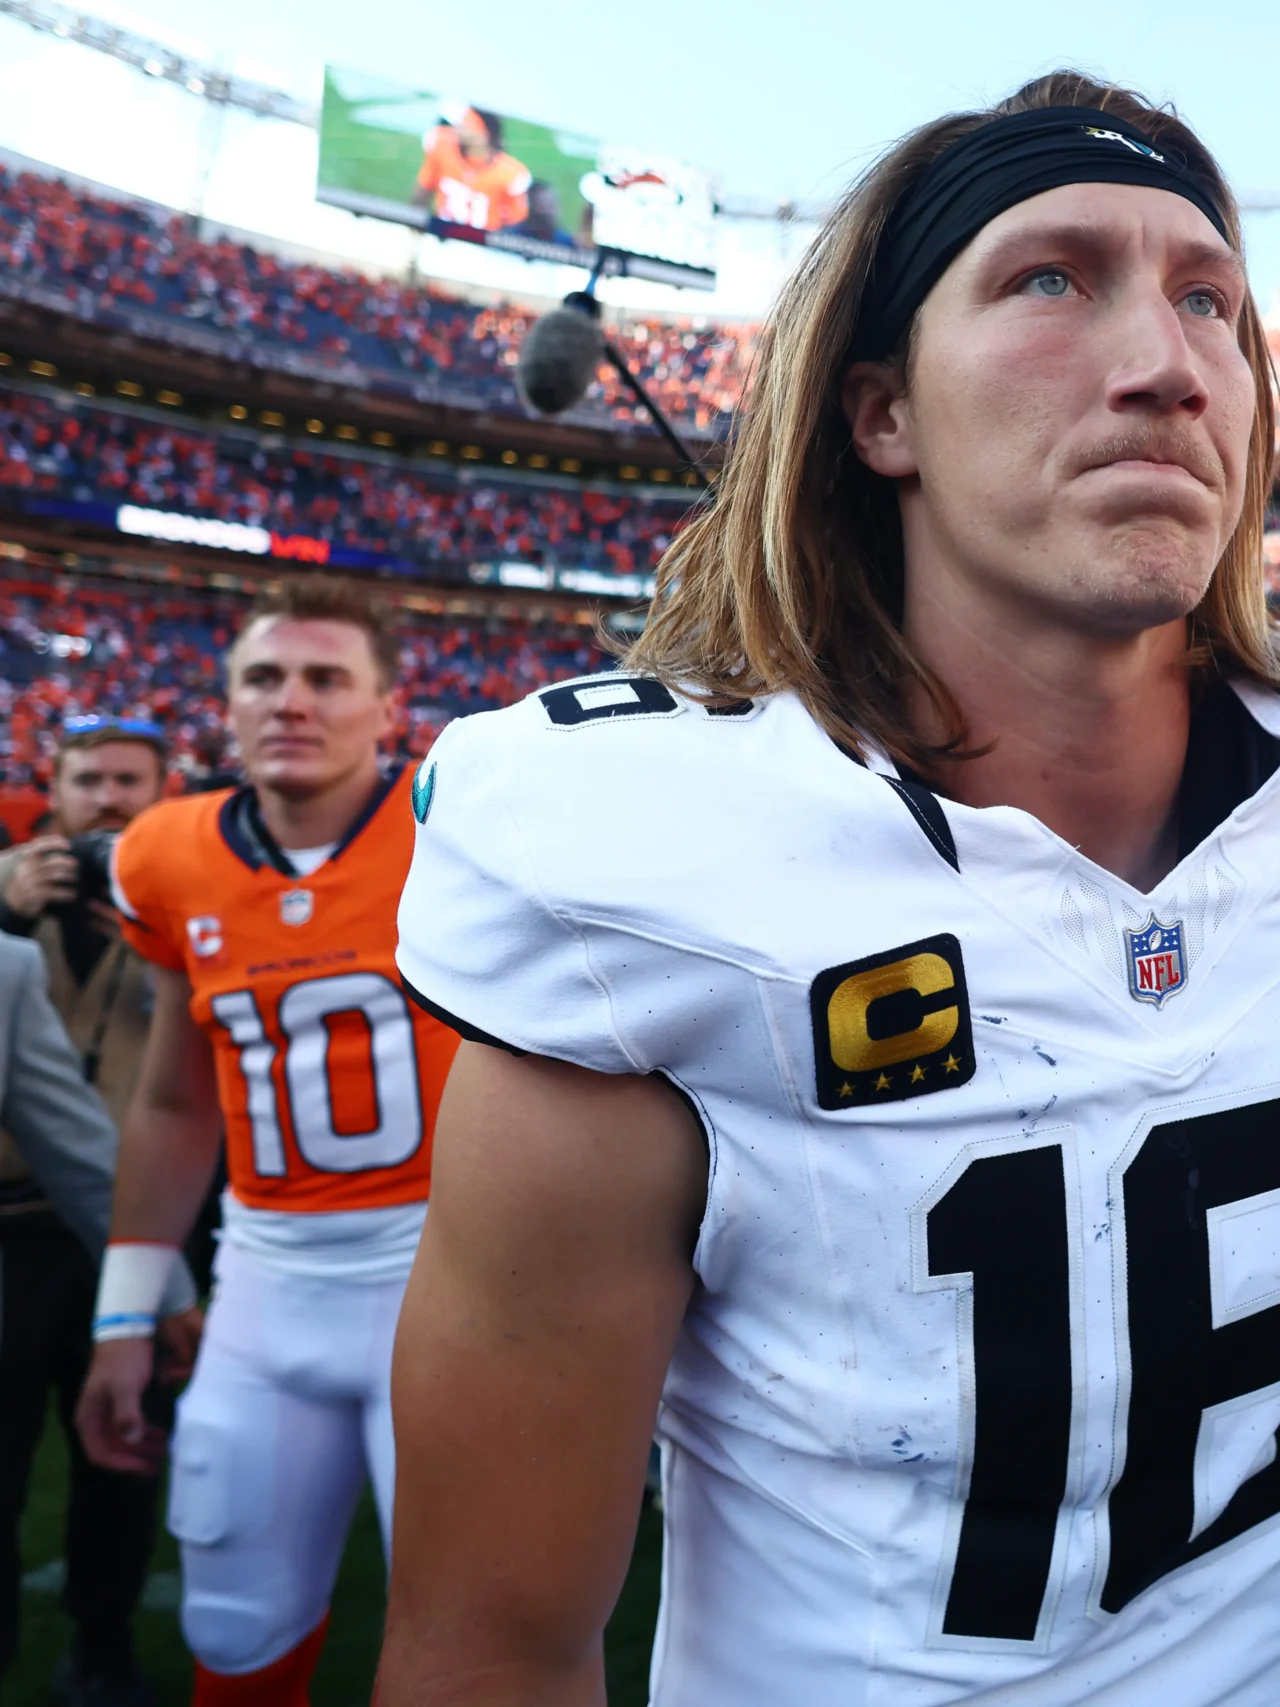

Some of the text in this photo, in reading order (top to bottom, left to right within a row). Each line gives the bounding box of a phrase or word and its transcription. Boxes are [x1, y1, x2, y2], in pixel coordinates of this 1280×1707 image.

[827, 951, 959, 1074] C
[1137, 953, 1180, 992] NFL
[210, 971, 424, 1178] 10
